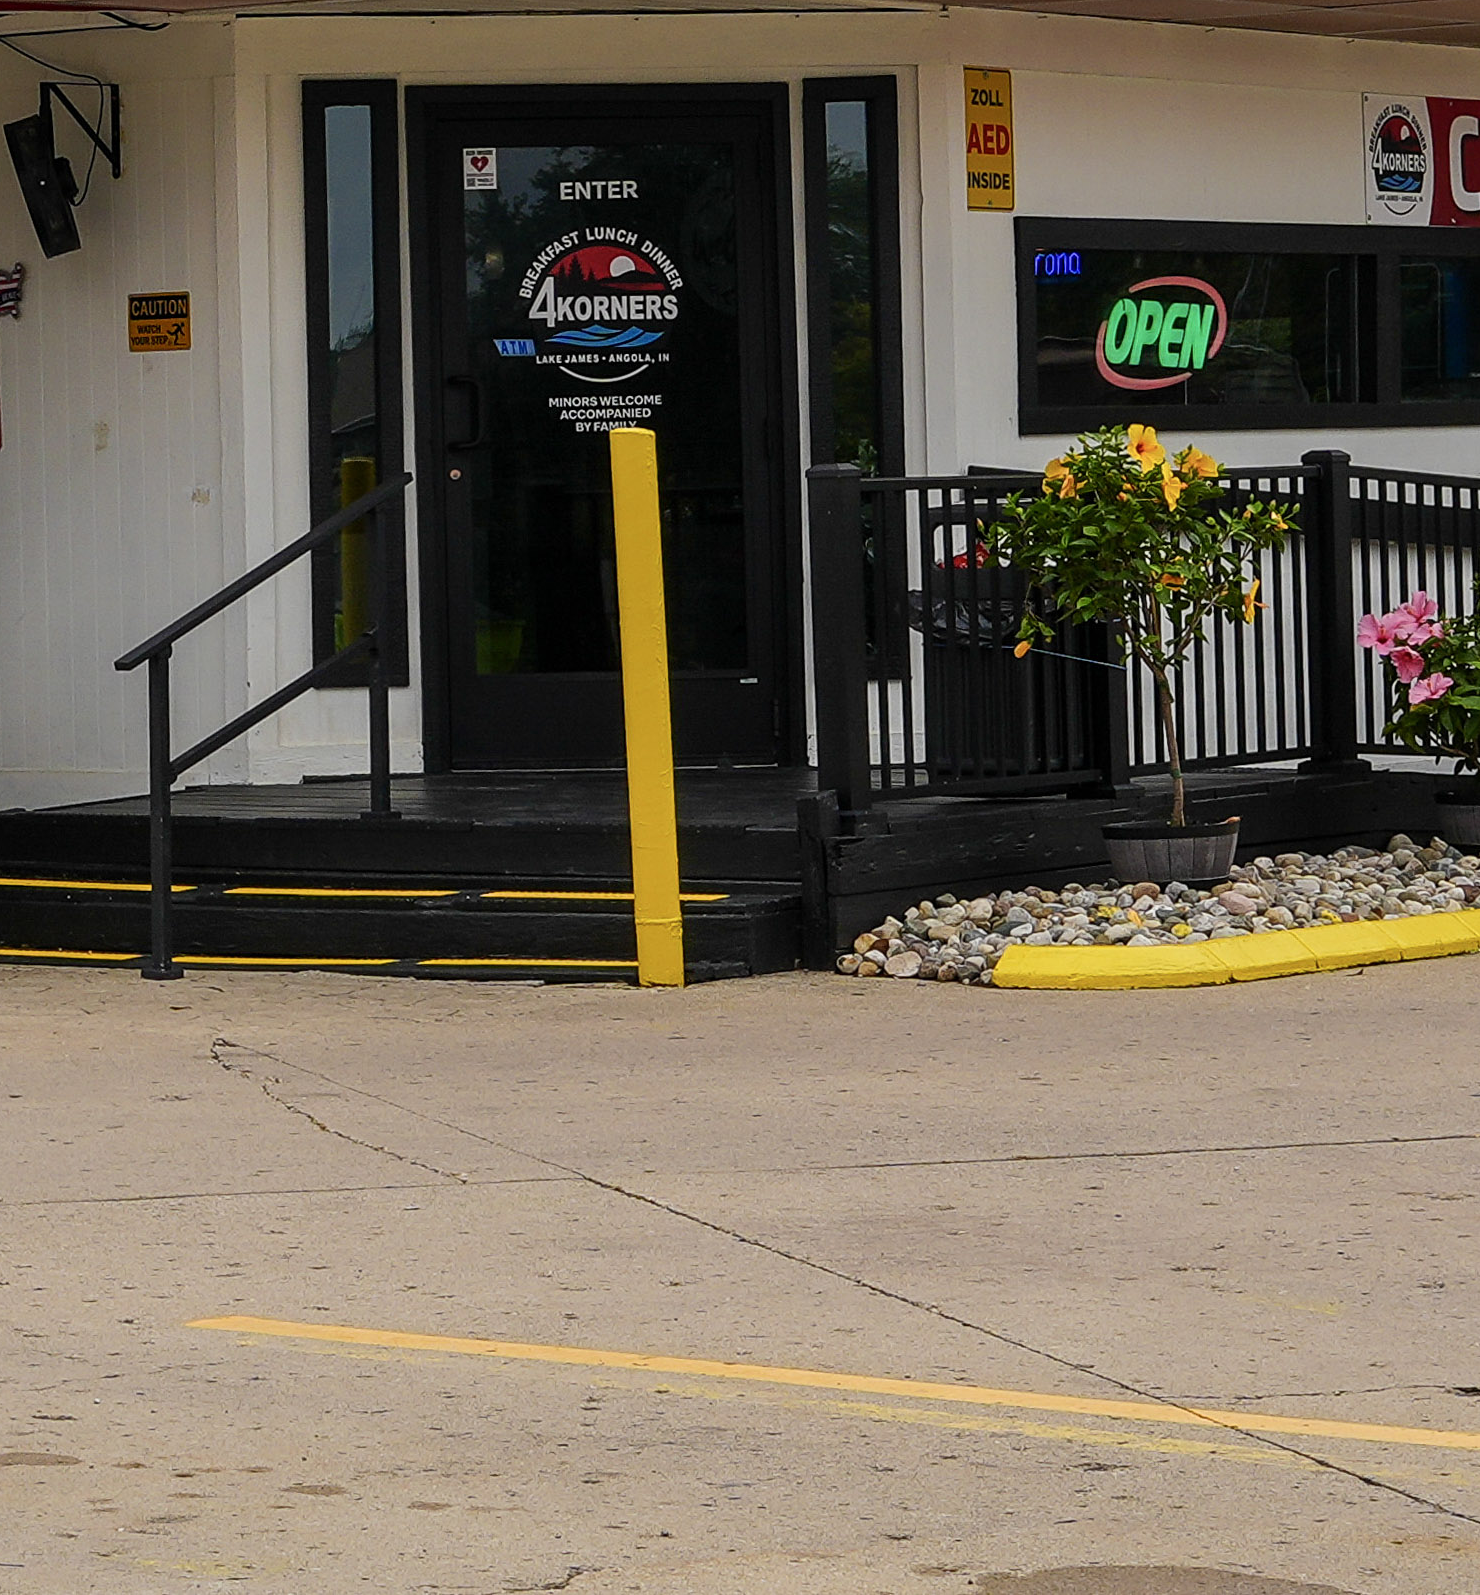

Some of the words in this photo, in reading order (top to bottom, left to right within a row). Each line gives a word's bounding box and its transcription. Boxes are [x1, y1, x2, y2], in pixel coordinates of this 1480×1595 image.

[971, 88, 1003, 106] ZOLL
[967, 123, 1010, 155] AED
[968, 171, 1010, 190] INSIDE
[560, 180, 639, 201] ENTER
[519, 231, 580, 298] BREAKFAST
[585, 227, 638, 246] LUNCH
[641, 240, 683, 290] DINNER
[132, 299, 187, 316] CAUTION
[529, 276, 678, 328] 4KORNERS
[137, 325, 161, 334] WATCH
[1105, 298, 1215, 369] OPEN
[130, 337, 150, 346] YOUR
[501, 341, 528, 355] ATM
[536, 355, 562, 364] LAKE
[564, 354, 599, 363] JAMES
[608, 353, 655, 364] ANGOLA,
[658, 353, 670, 362] IN
[549, 397, 598, 408] MINORS
[599, 394, 662, 407] WELCOME
[560, 408, 651, 420] ACCOMPANIED
[576, 422, 591, 432] BY
